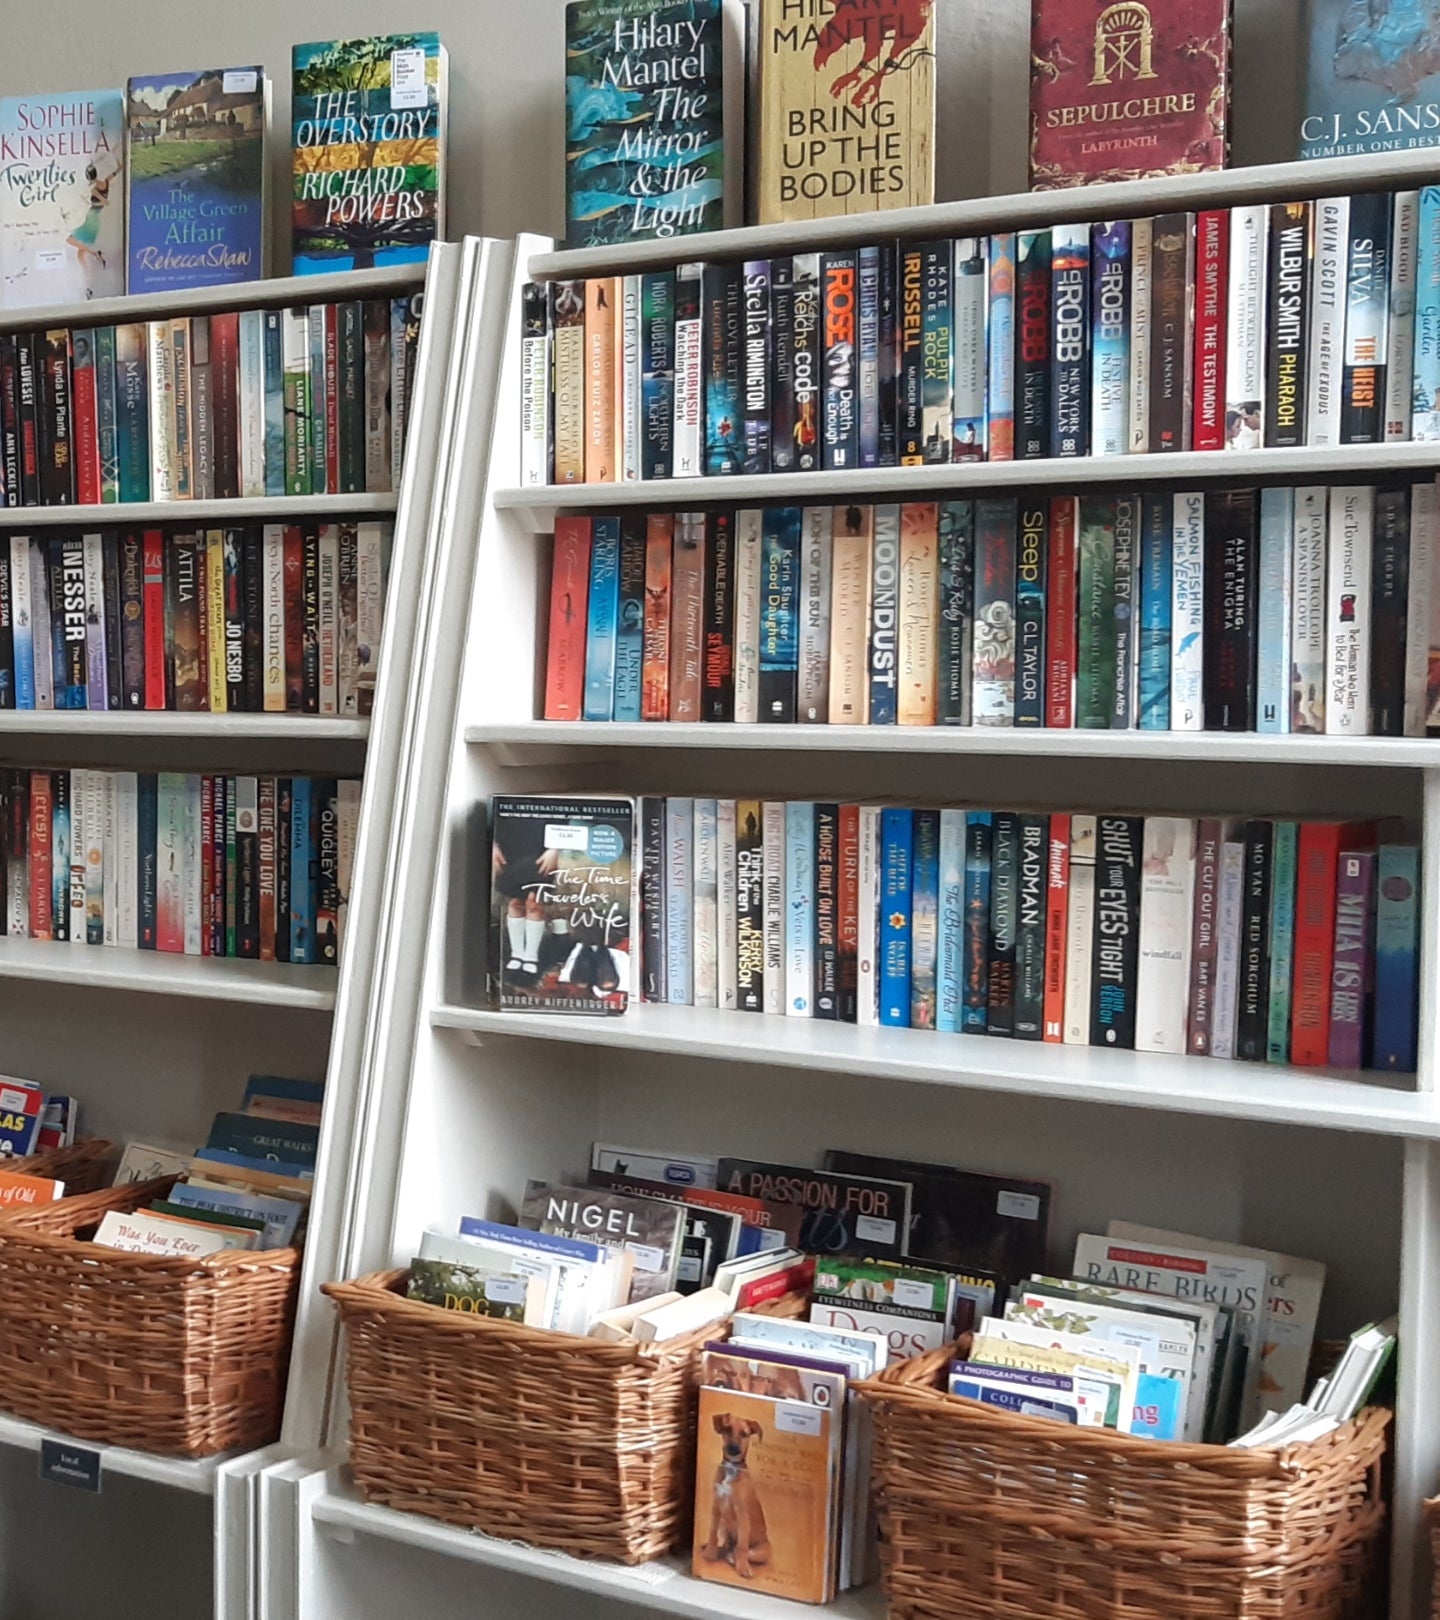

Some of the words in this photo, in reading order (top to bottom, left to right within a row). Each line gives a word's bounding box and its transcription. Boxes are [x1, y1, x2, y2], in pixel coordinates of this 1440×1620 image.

[615, 11, 707, 52] Hilary
[774, 14, 915, 53] MANTEL
[600, 44, 705, 89] Mantel
[17, 102, 95, 130] SOPHIE
[312, 90, 358, 119] THE
[654, 87, 706, 121] The
[788, 100, 896, 137] BRING
[1046, 93, 1196, 128] SEPULCHRE
[1, 130, 110, 159] KINSELLA
[297, 110, 430, 148] OVERSTORY
[616, 129, 707, 162] Mirror
[1081, 136, 1158, 154] LABYRINTH
[1301, 114, 1347, 145] C.J.
[782, 138, 826, 169] UP
[832, 132, 901, 164] THE
[1302, 143, 1365, 158] NUMBER
[1371, 140, 1400, 151] ONE
[0, 158, 77, 191] Twenties
[303, 166, 406, 200] RICHARD
[630, 167, 654, 194] &
[664, 166, 706, 190] the
[780, 166, 904, 201] BODIES
[20, 182, 59, 208] Girl
[144, 205, 194, 222] Village
[200, 202, 247, 219] Green
[168, 190, 194, 205] The
[325, 190, 424, 227] POWERS
[164, 223, 225, 244] Affair
[632, 198, 705, 237] Light
[1206, 217, 1218, 258] JAMES
[136, 246, 206, 271] Rebecca
[207, 244, 251, 269] Shaw
[1280, 227, 1303, 293] WILBUR
[1350, 239, 1372, 305] SILVA
[746, 275, 766, 336] Stella
[827, 269, 853, 346] ROSE
[905, 259, 919, 351] RUSSELL
[1204, 263, 1217, 316] SMYTHE
[1057, 285, 1082, 361] ROBB
[1204, 325, 1217, 350] THE
[1278, 297, 1300, 348] SMITH
[1355, 336, 1376, 360] THE
[747, 340, 765, 410] RIMINGTON
[1203, 354, 1216, 427] TESTIMONY
[1277, 355, 1296, 426] PHARAOH
[1352, 367, 1375, 408] HEIST
[296, 381, 304, 413] LIANE
[296, 418, 304, 476] MORIARTY
[1019, 511, 1043, 581] Sleep
[179, 549, 193, 602] ATTILA
[63, 552, 85, 640] NESSER
[873, 516, 894, 687] MOONDUST
[226, 621, 241, 637] JO
[226, 641, 242, 682] NESBO
[707, 633, 722, 687] SEYMOUR
[517, 804, 579, 812] INTERNATIONAL
[583, 806, 630, 814] BESTSELLER
[321, 810, 333, 878] QUIGLEY
[1102, 820, 1134, 866] SHUT
[548, 868, 581, 884] The
[585, 866, 629, 884] Time
[1022, 827, 1040, 923] BRADMAN
[1109, 865, 1123, 887] YOUR
[570, 903, 628, 945] Wife
[1100, 889, 1128, 935] EYES
[1100, 938, 1123, 983] TIGHT
[500, 995, 540, 1006] AUDREY
[545, 997, 616, 1009] NIFFENEGGER
[3, 1185, 16, 1202] of
[15, 1188, 36, 1202] Old
[728, 1170, 742, 1191] A
[750, 1172, 837, 1209] PASSION
[846, 1188, 888, 1217] FOR
[547, 1197, 640, 1237] NIGEL
[118, 1225, 142, 1240] Was
[147, 1231, 167, 1246] You
[173, 1238, 201, 1253] Ever
[1087, 1262, 1160, 1290] RARE
[1175, 1275, 1257, 1311] BIRDS
[818, 1296, 874, 1311] EYEWITNESS
[876, 1303, 937, 1320] COMPANIONS
[826, 1311, 927, 1355] Dogs
[964, 1366, 1028, 1384] PHOTOGRAPHIC
